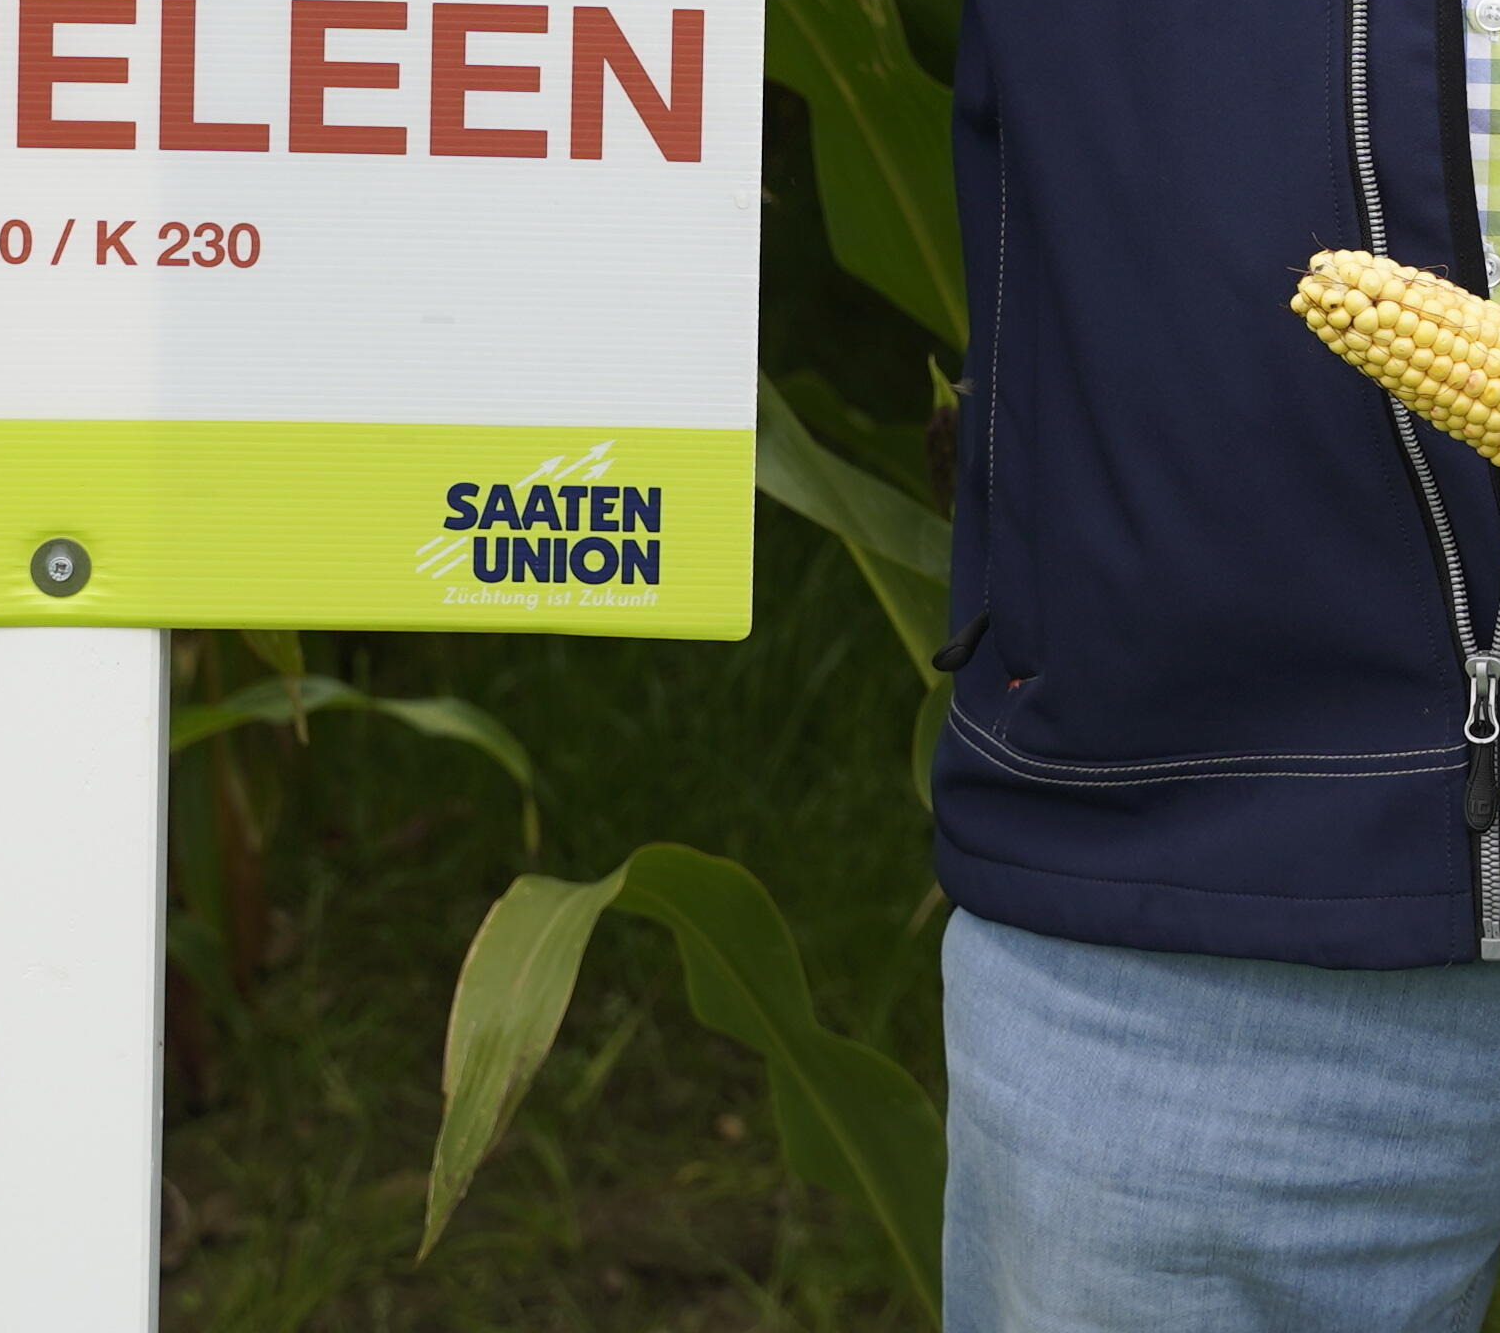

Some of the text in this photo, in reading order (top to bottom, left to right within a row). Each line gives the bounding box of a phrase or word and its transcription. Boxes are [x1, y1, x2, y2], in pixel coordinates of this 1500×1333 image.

[50, 219, 76, 266] /
[95, 220, 138, 266] K
[156, 222, 261, 268] 230
[443, 482, 662, 533] SAATEN
[473, 536, 661, 585] UNION
[442, 586, 659, 610] Züchtung ist Zukunft
